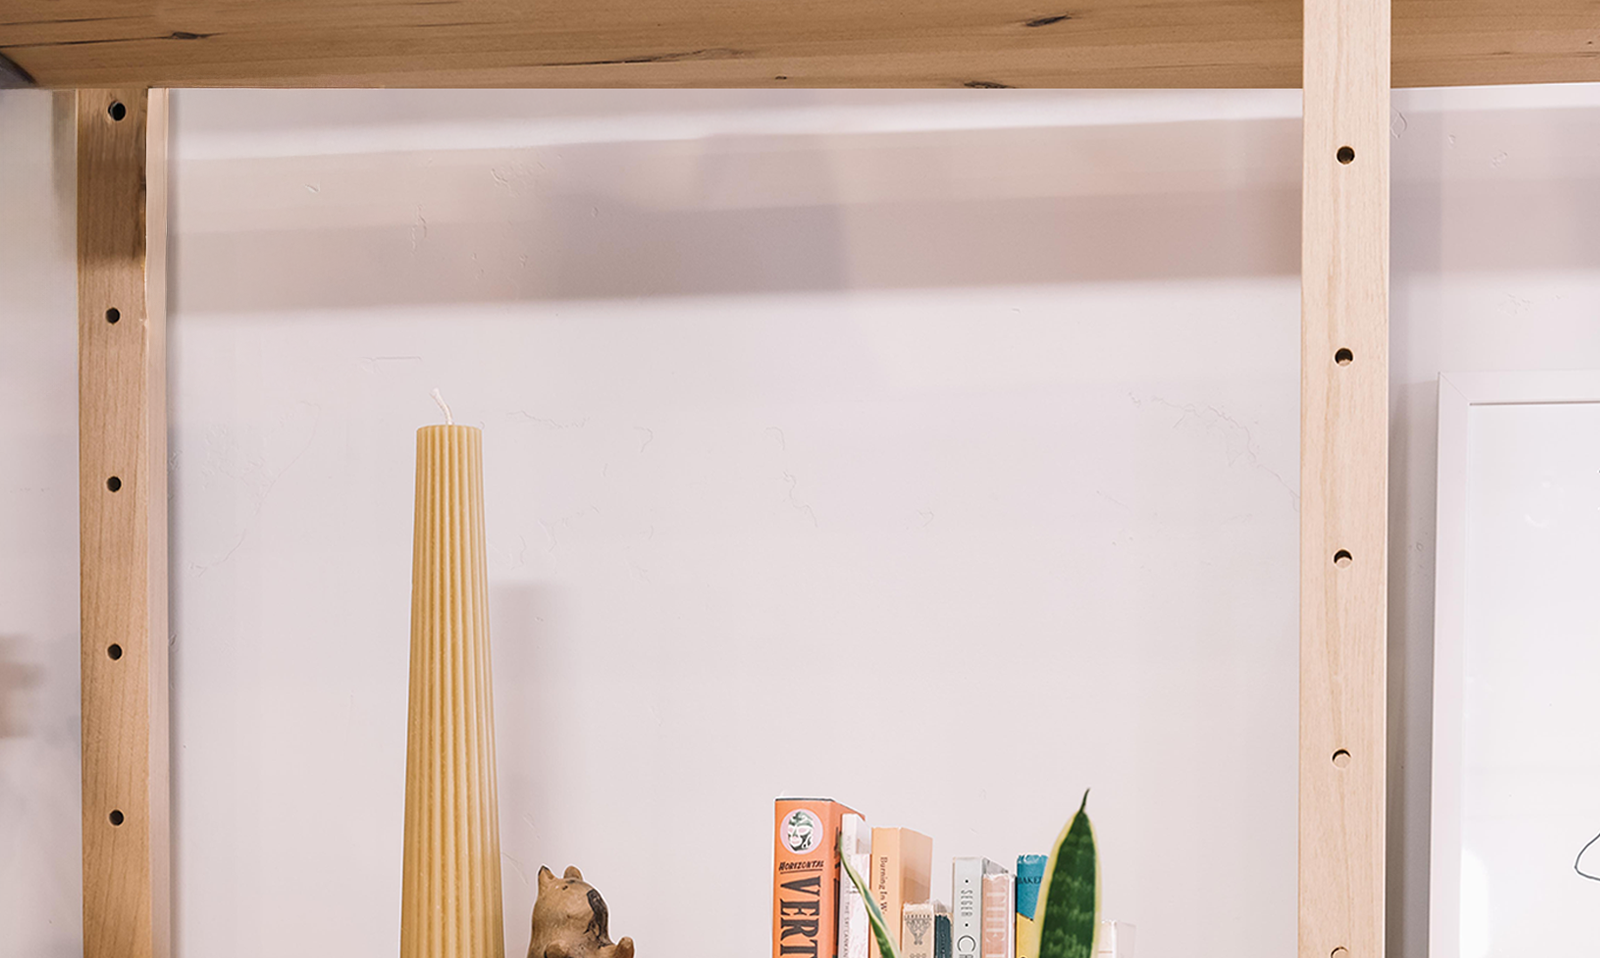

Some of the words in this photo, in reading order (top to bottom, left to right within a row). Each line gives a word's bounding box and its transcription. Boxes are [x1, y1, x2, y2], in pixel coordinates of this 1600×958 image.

[879, 856, 888, 890] Burning
[960, 889, 973, 917] SEGER
[985, 884, 1007, 943] THE
